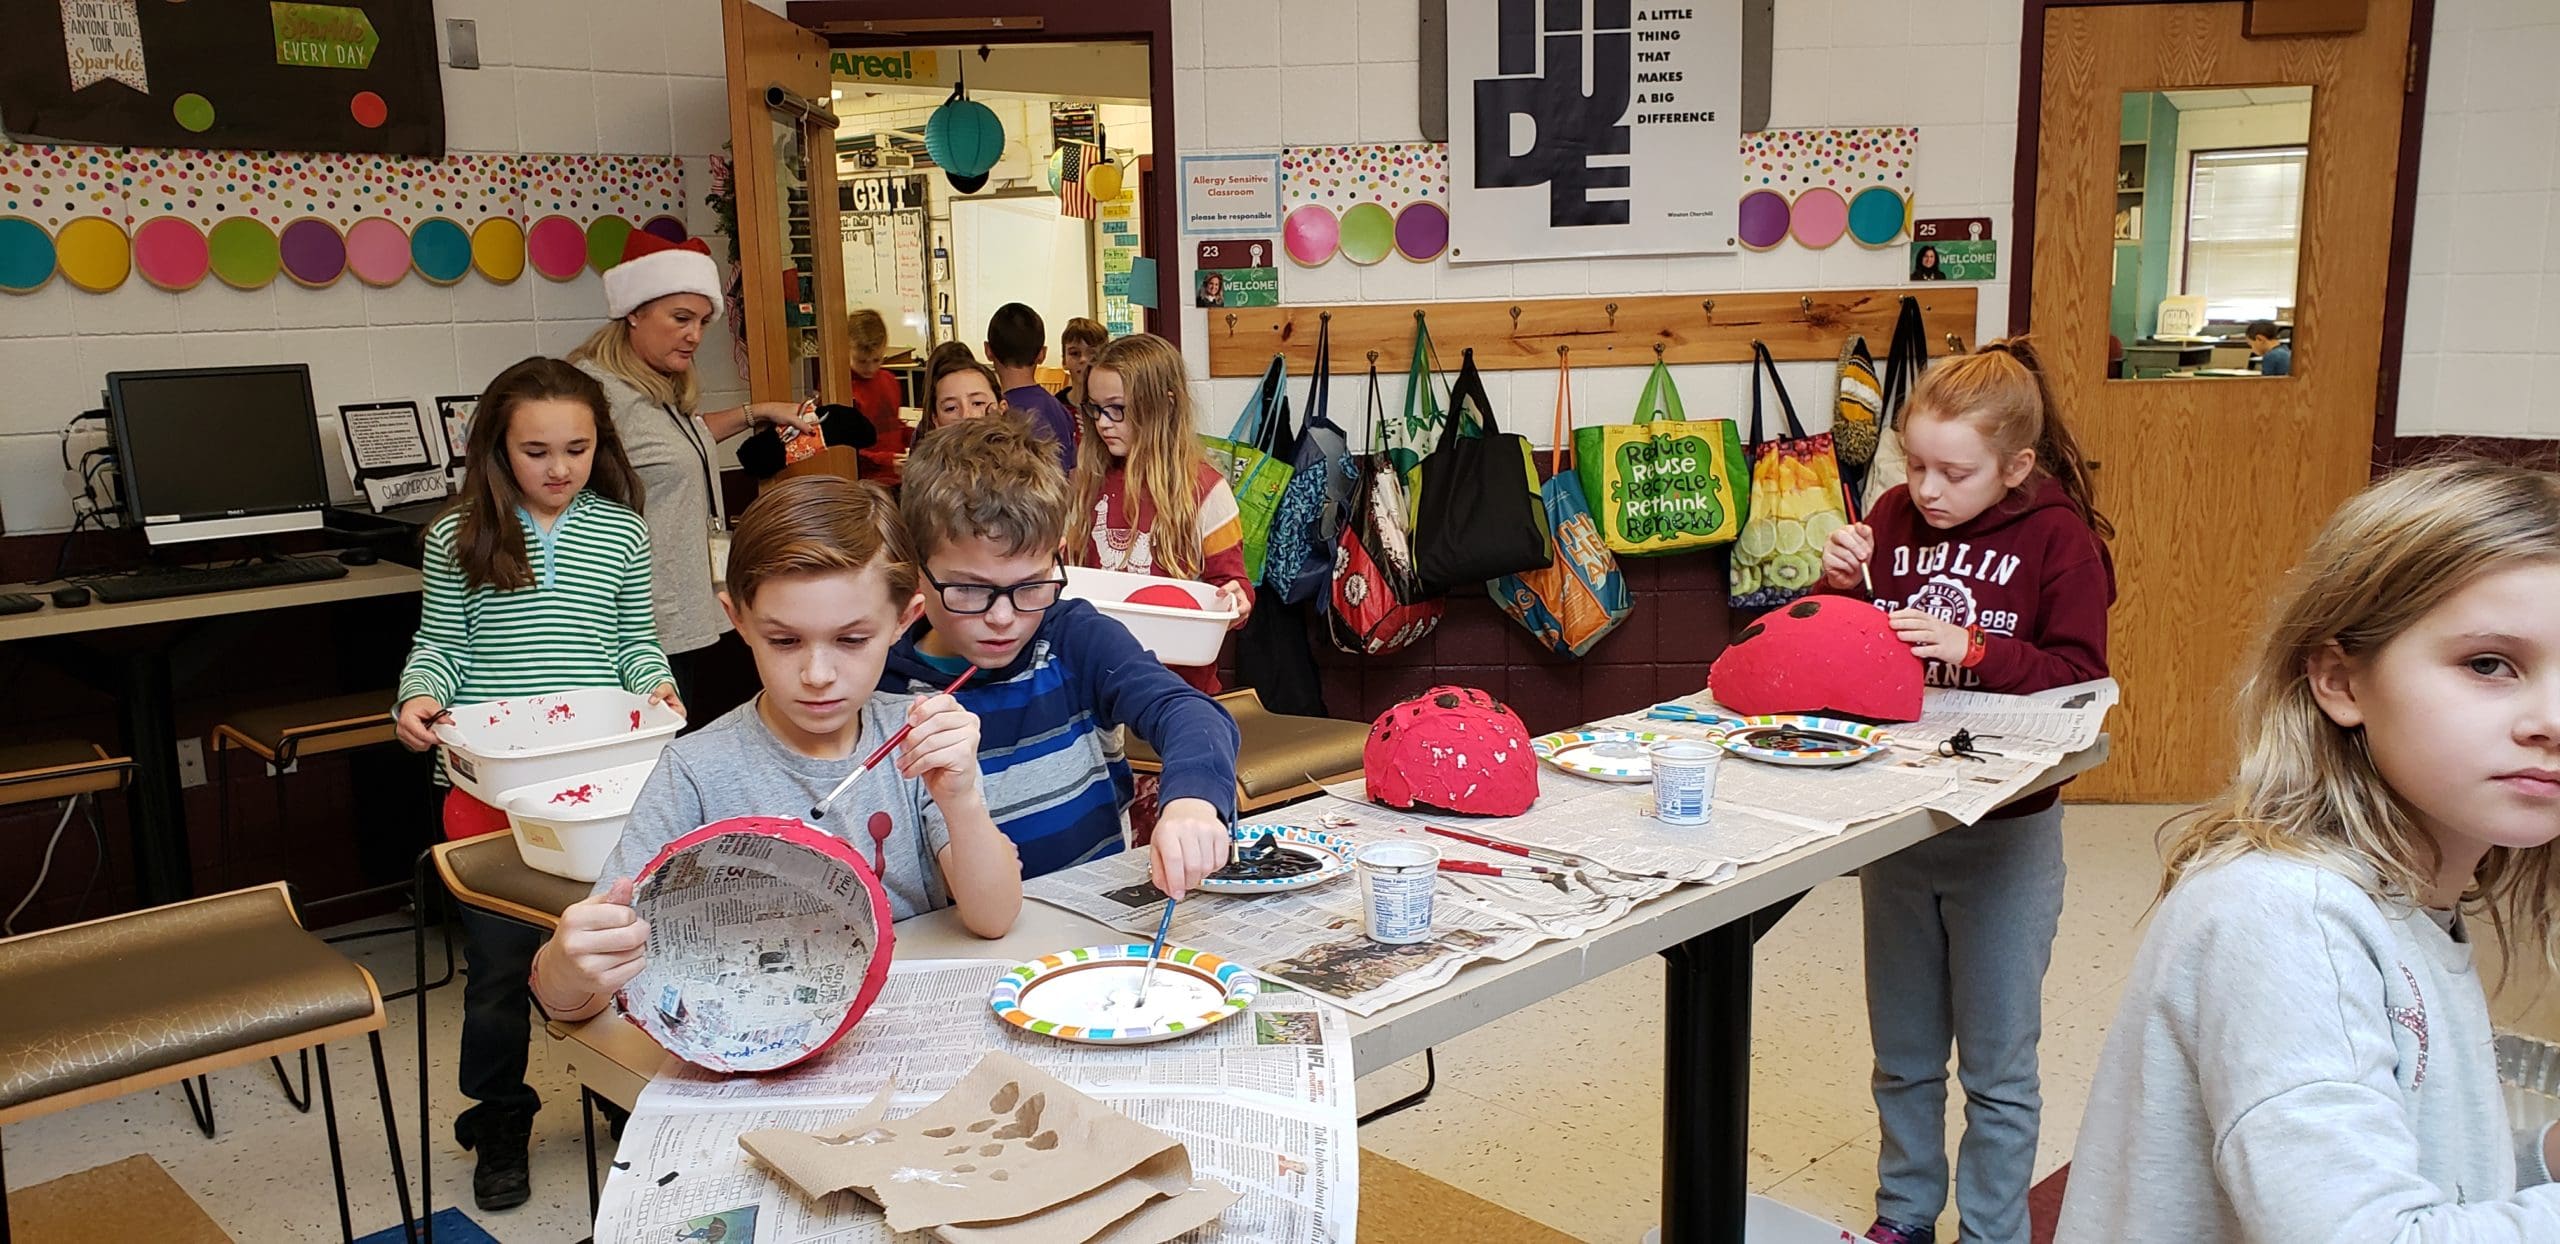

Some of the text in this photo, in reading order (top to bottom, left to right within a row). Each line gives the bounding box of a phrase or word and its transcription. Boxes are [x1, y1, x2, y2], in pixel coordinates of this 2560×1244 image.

[76, 3, 123, 20] DON'T LET
[1637, 9, 1693, 21] A LITTLE
[71, 20, 133, 37] ANYONE DULL
[1637, 30, 1681, 42] THING
[90, 37, 114, 52] YOUR
[283, 41, 364, 64] EVERY DAY
[73, 47, 142, 74] Sparkle
[830, 51, 912, 79] Area!
[1637, 51, 1671, 62] THAT
[1637, 71, 1683, 83] MAKES
[1637, 92, 1675, 103] A BIG
[1637, 111, 1716, 124] DIFFERENCE
[1193, 174, 1269, 186] Allergy Sensitive
[853, 178, 906, 212] GRIT
[1207, 188, 1255, 197] Classroom
[1191, 211, 1273, 222] please be responsible
[1919, 223, 1937, 236] 25
[1202, 246, 1220, 258] 23
[1940, 253, 1996, 264] WELCOME!
[1223, 280, 1278, 291] WELCOME!
[1626, 440, 1697, 465] Reduce
[1631, 456, 1697, 484] Reuse
[1628, 474, 1707, 500] Recycle
[1626, 491, 1708, 518] Rethink
[1626, 510, 1715, 539] Renew
[1893, 541, 2021, 586] DUBLIN
[1306, 1047, 1325, 1071] NFL
[1314, 1126, 1328, 1147] Talk
[1315, 1157, 1328, 1179] boss
[1315, 1179, 1329, 1210] about
